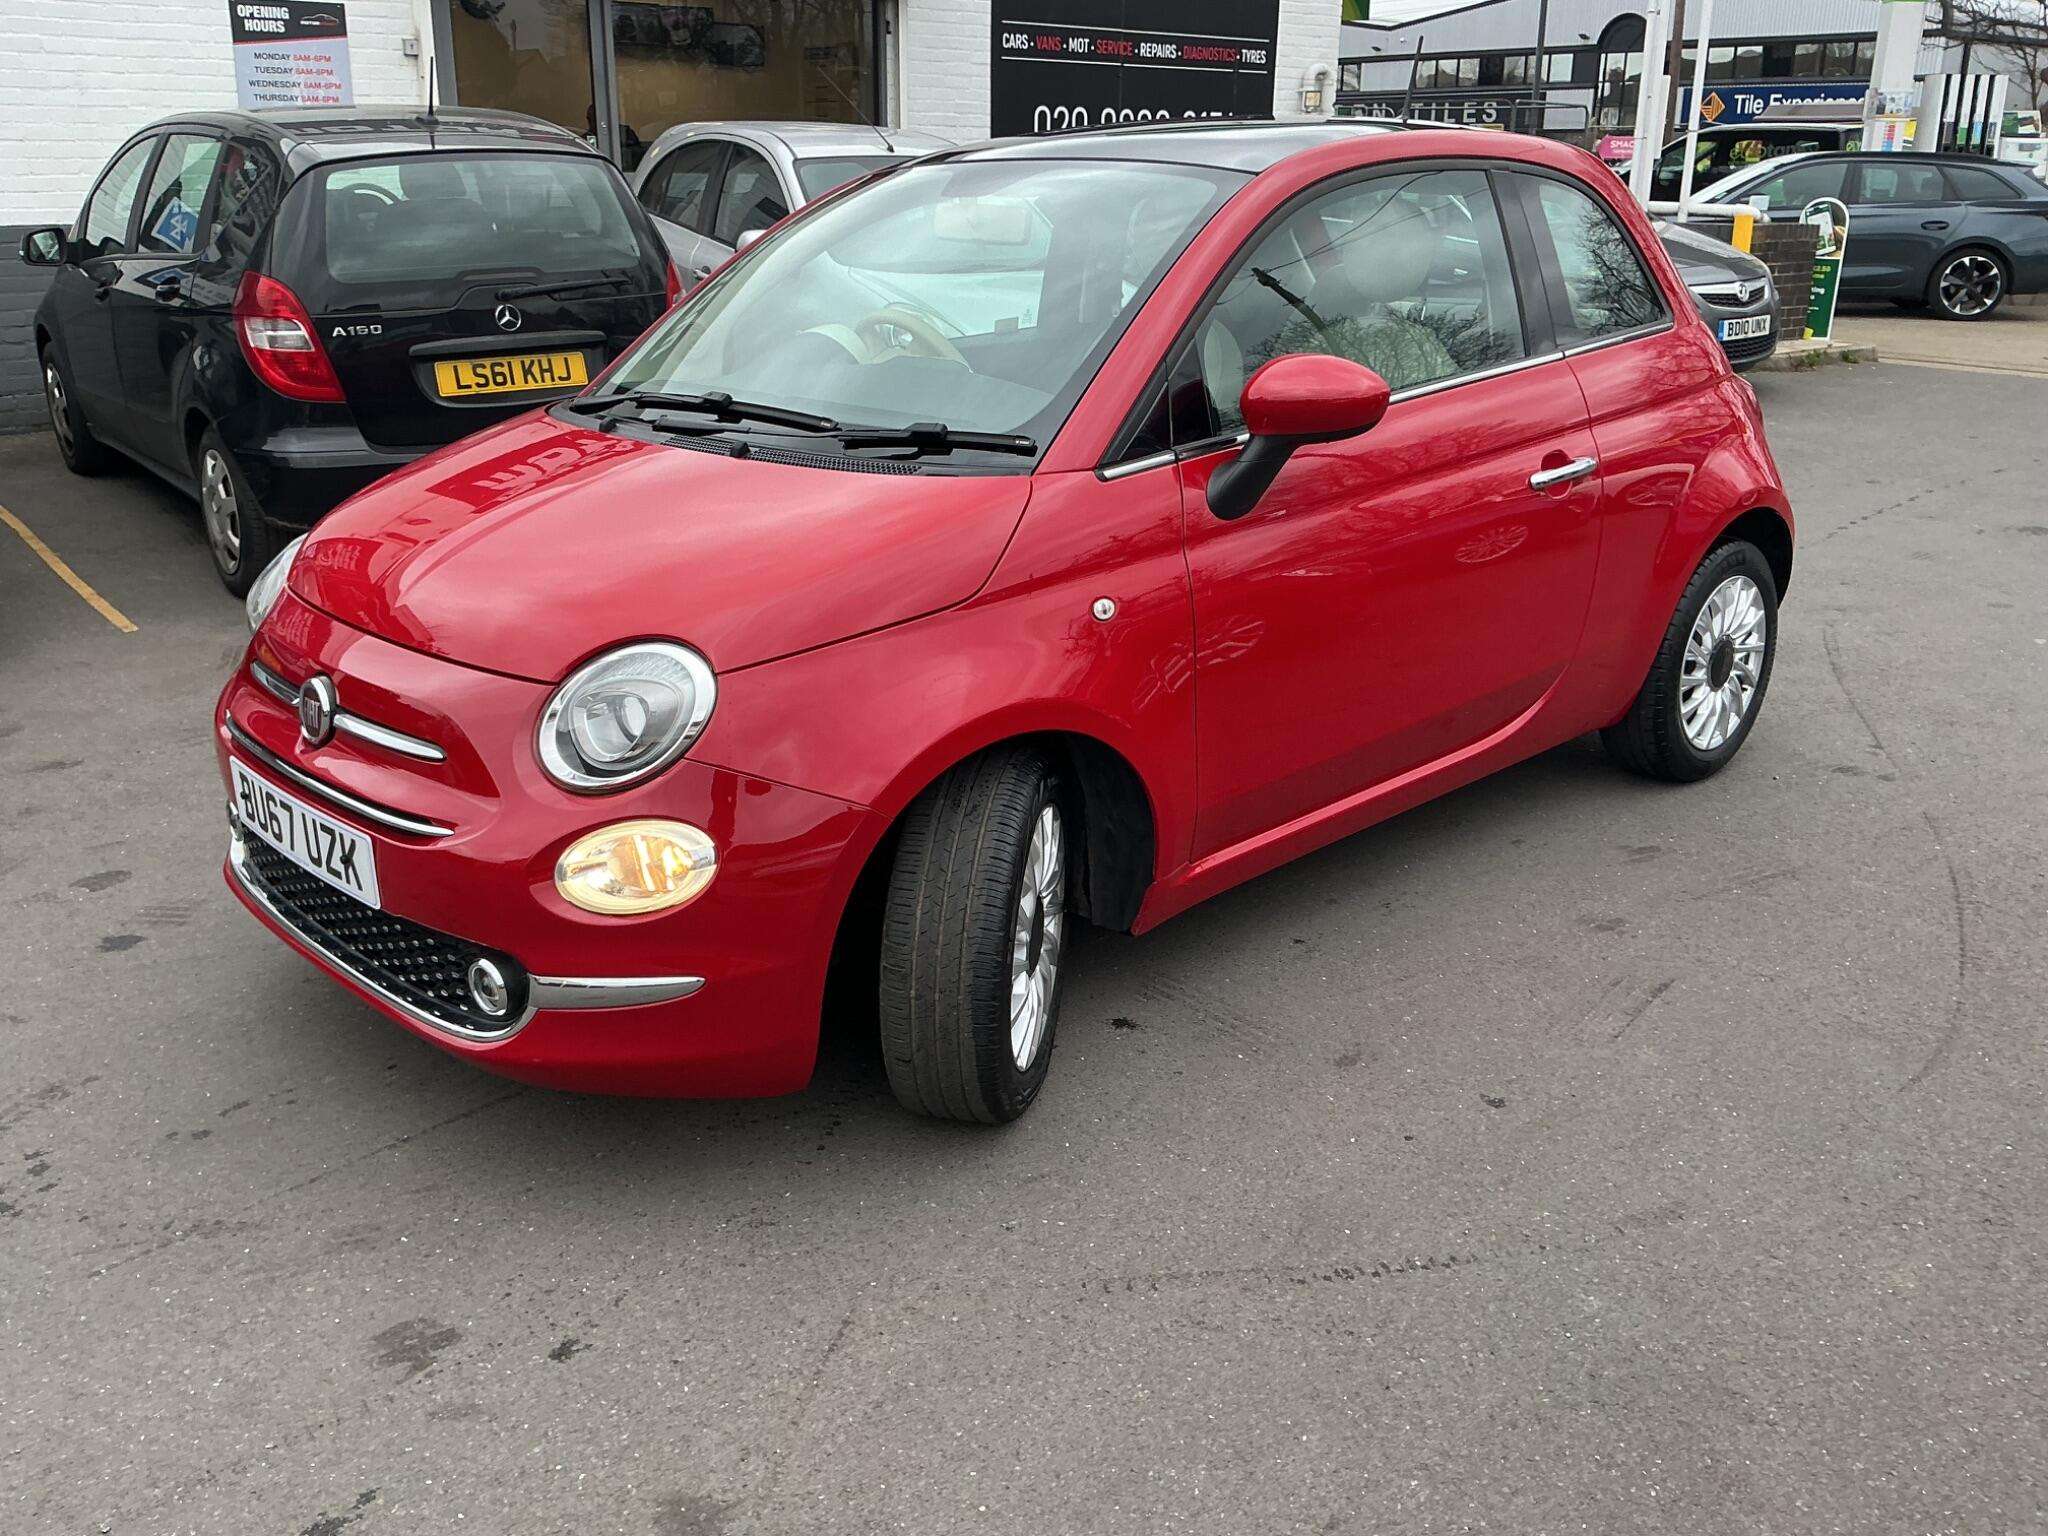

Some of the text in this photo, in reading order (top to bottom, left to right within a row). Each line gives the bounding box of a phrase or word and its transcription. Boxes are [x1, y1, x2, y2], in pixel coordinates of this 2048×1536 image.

[236, 4, 289, 19] OPENING
[244, 19, 286, 33] HOURS
[253, 52, 290, 61] MONDAY
[1002, 33, 1267, 64] CARS VANS MOT SERVICE REPAIRS DIAGNOSTICS TYRES
[254, 66, 293, 75] TUESDAY
[248, 79, 301, 89] WEDNESDAY
[253, 93, 299, 103] THURSDAY
[1734, 94, 1764, 114] Tile
[1411, 101, 1497, 123] TILES
[1727, 319, 1750, 337] BD10
[452, 356, 573, 390] LS61 KHJ
[239, 770, 364, 892] BU67 UZK
